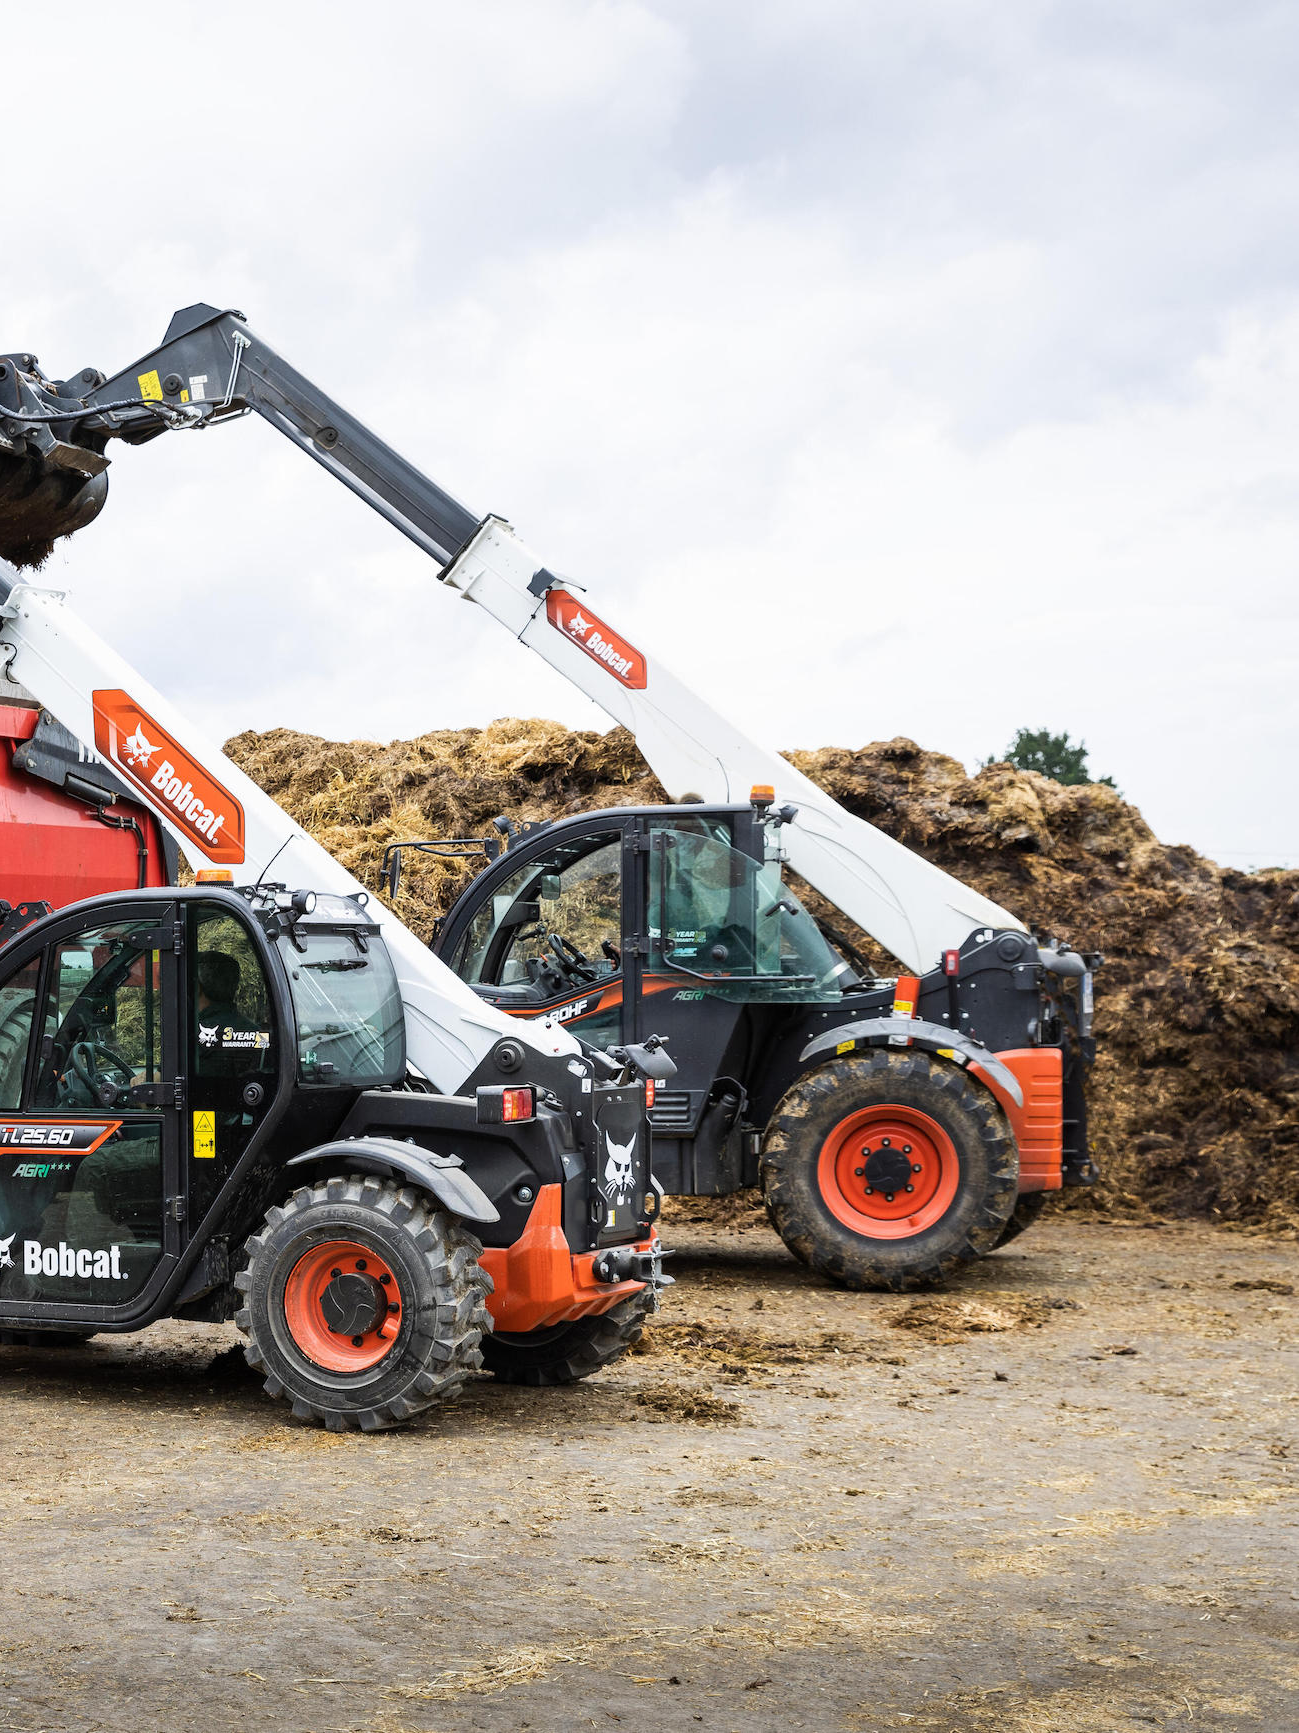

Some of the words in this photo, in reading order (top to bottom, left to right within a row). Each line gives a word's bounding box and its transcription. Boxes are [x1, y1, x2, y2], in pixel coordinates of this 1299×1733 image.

[585, 631, 634, 677] Bobcat
[150, 759, 226, 845] Bobcat
[672, 990, 707, 1001] AGRI
[222, 1026, 234, 1041] 3
[233, 1031, 256, 1041] YEAR
[1, 1127, 75, 1145] TL25.60
[12, 1163, 50, 1178] AGRI
[23, 1239, 122, 1280] Bobcat
